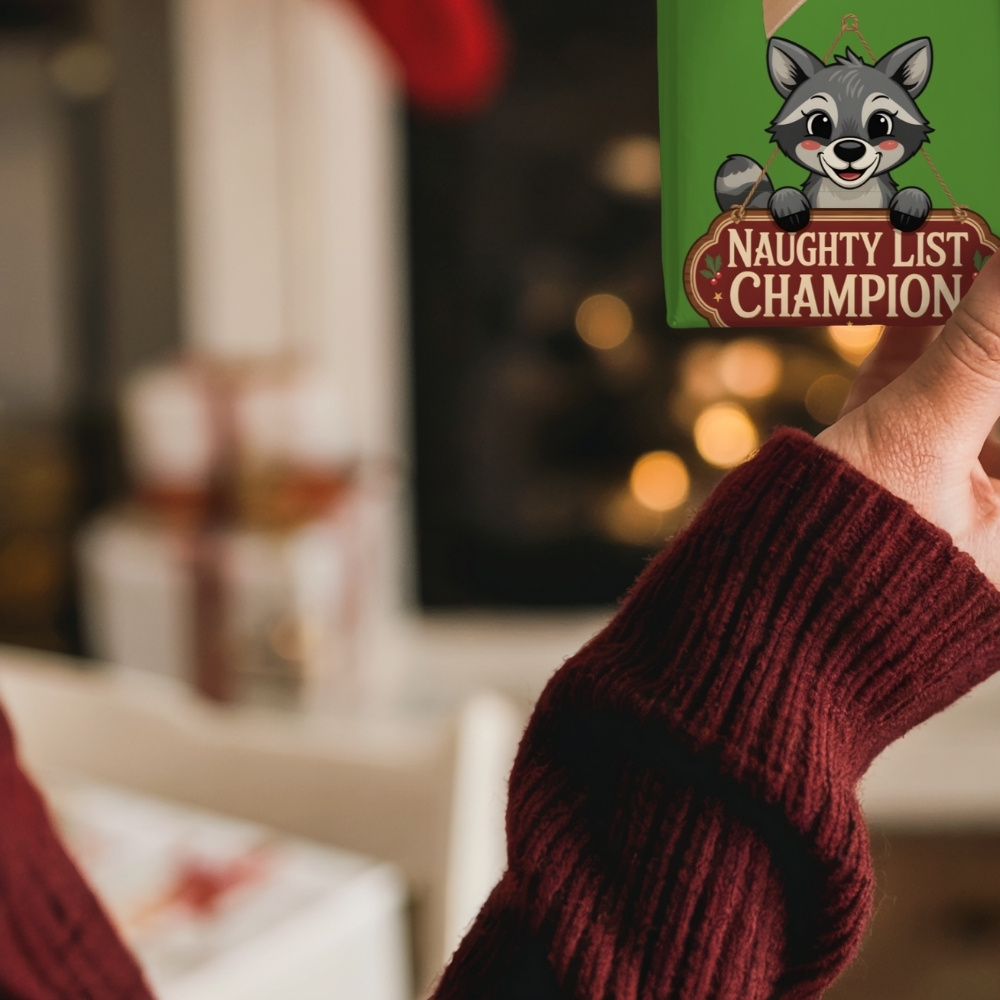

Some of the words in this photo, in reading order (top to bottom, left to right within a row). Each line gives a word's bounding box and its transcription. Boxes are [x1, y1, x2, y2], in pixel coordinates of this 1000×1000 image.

[727, 228, 883, 268] NAUGHTY
[892, 228, 969, 268] LIST
[729, 271, 963, 319] CHAMPION
